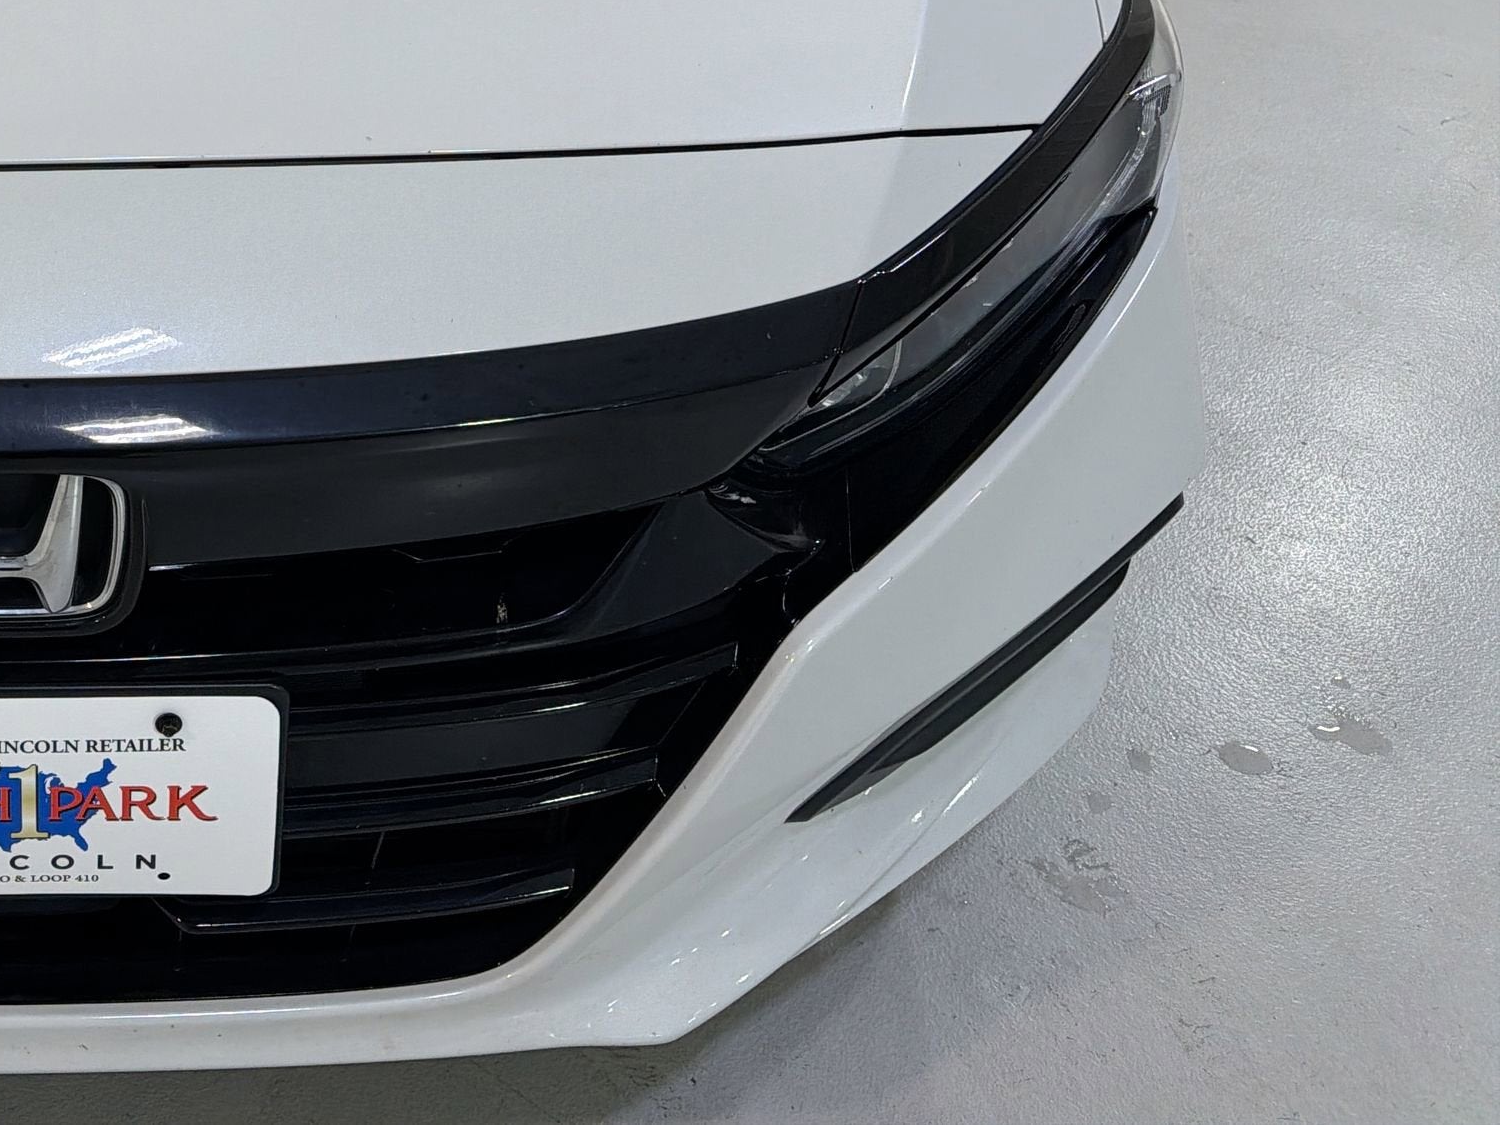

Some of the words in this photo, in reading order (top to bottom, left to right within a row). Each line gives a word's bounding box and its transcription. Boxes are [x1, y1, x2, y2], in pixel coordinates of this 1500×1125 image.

[85, 738, 186, 753] RETAILER
[49, 785, 219, 821] PARK
[14, 875, 26, 883] &
[31, 874, 71, 883] LOOP
[75, 874, 99, 882] 410
